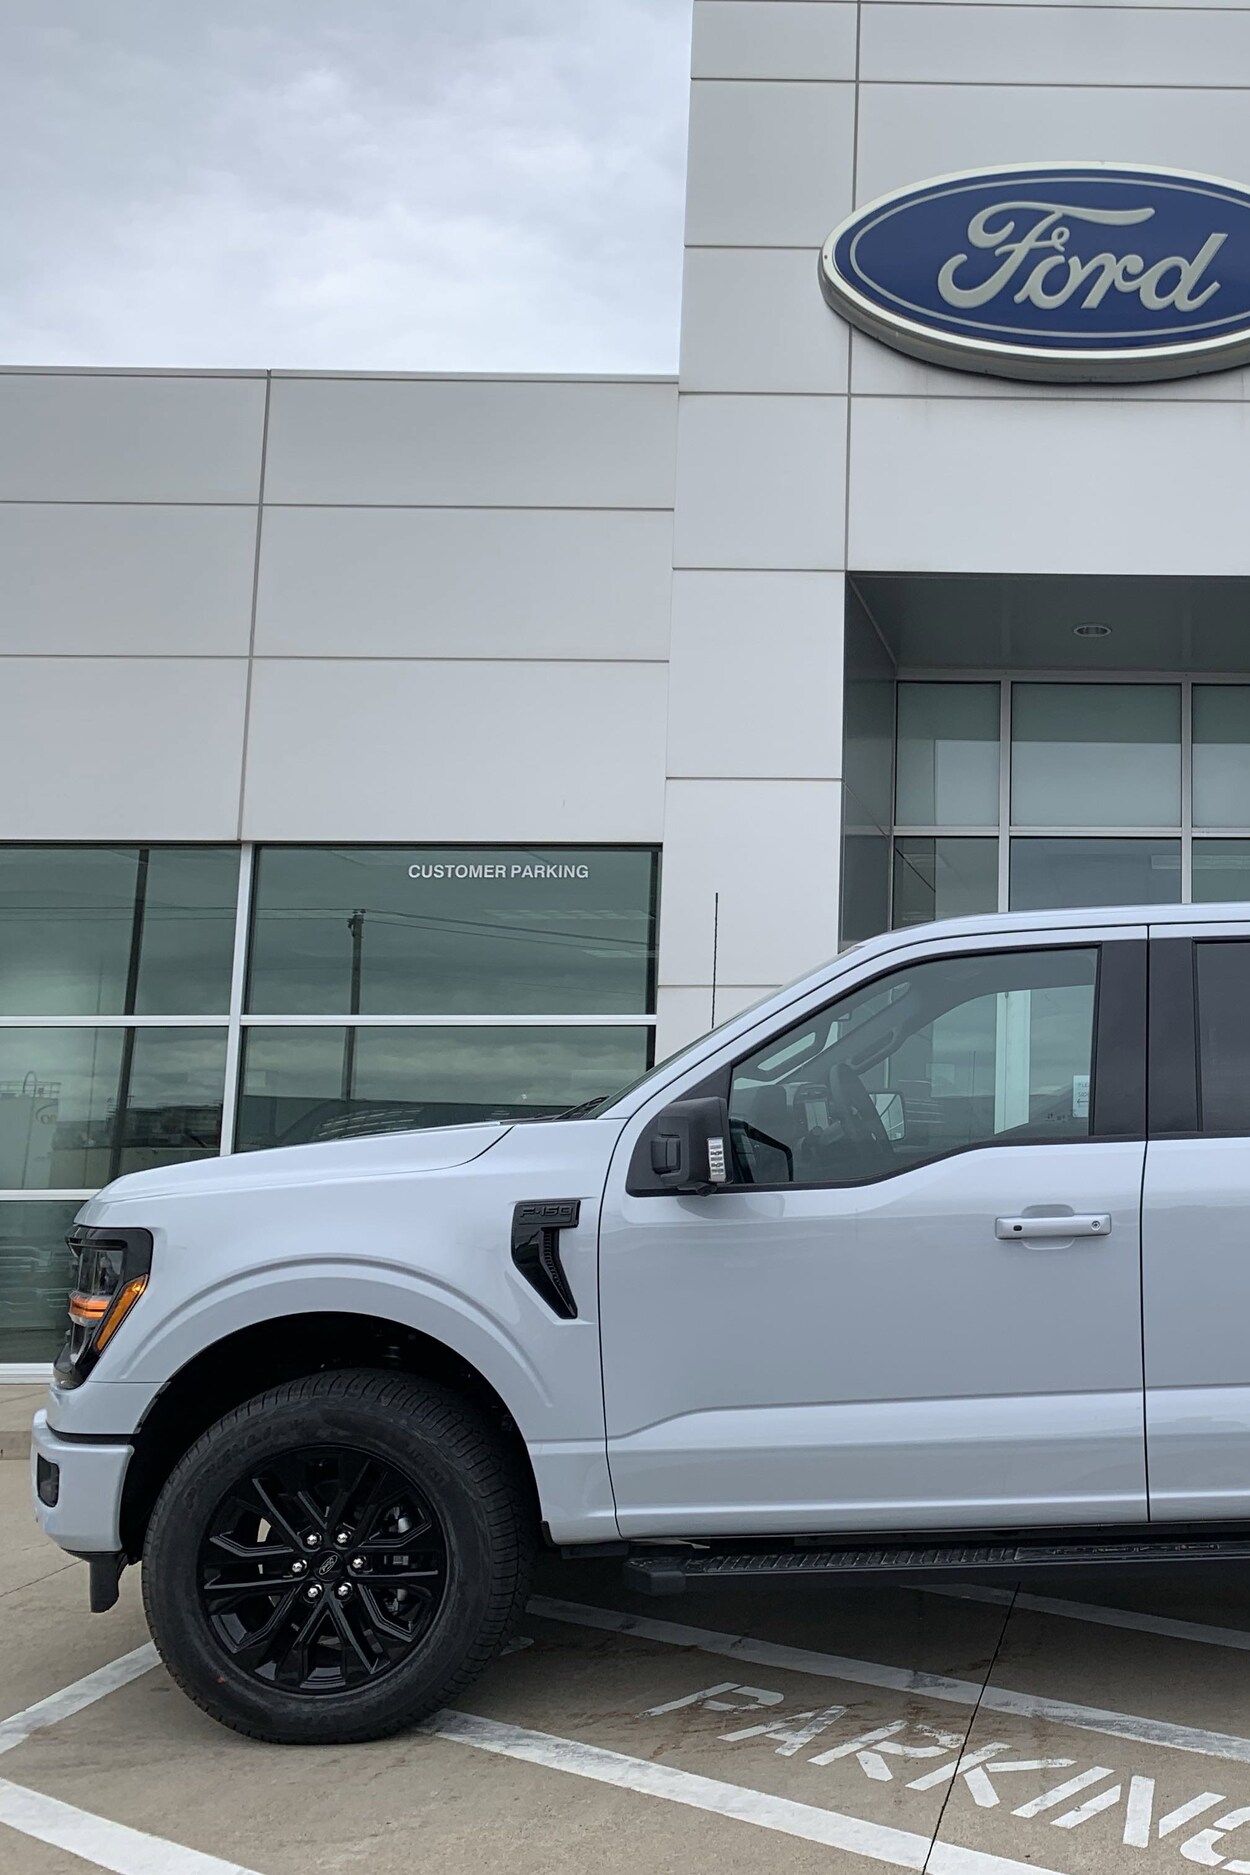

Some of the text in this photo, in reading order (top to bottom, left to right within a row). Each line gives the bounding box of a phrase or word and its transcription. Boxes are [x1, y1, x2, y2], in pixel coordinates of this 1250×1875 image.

[937, 200, 1229, 313] Ford
[408, 864, 589, 879] CUSTOMER PARKING
[519, 1205, 574, 1218] F-150
